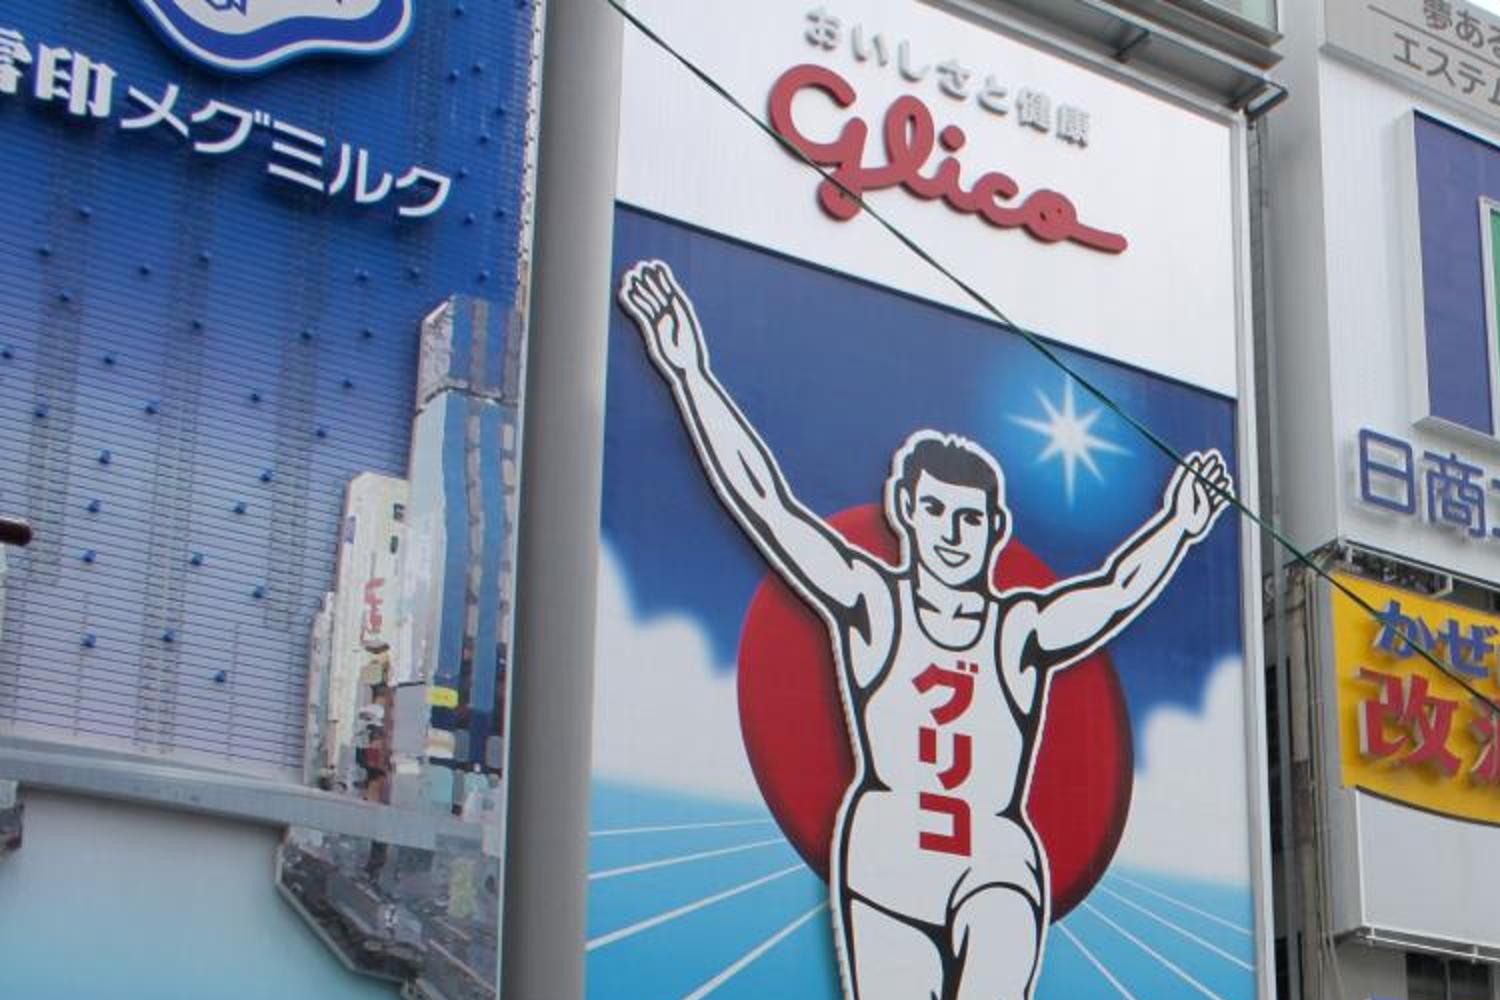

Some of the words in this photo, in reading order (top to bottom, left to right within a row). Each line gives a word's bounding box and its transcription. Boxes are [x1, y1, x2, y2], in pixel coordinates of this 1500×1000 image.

[768, 63, 1128, 254] Glico
[803, 6, 1091, 149] おいしさと健康
[911, 660, 979, 857] グリコ
